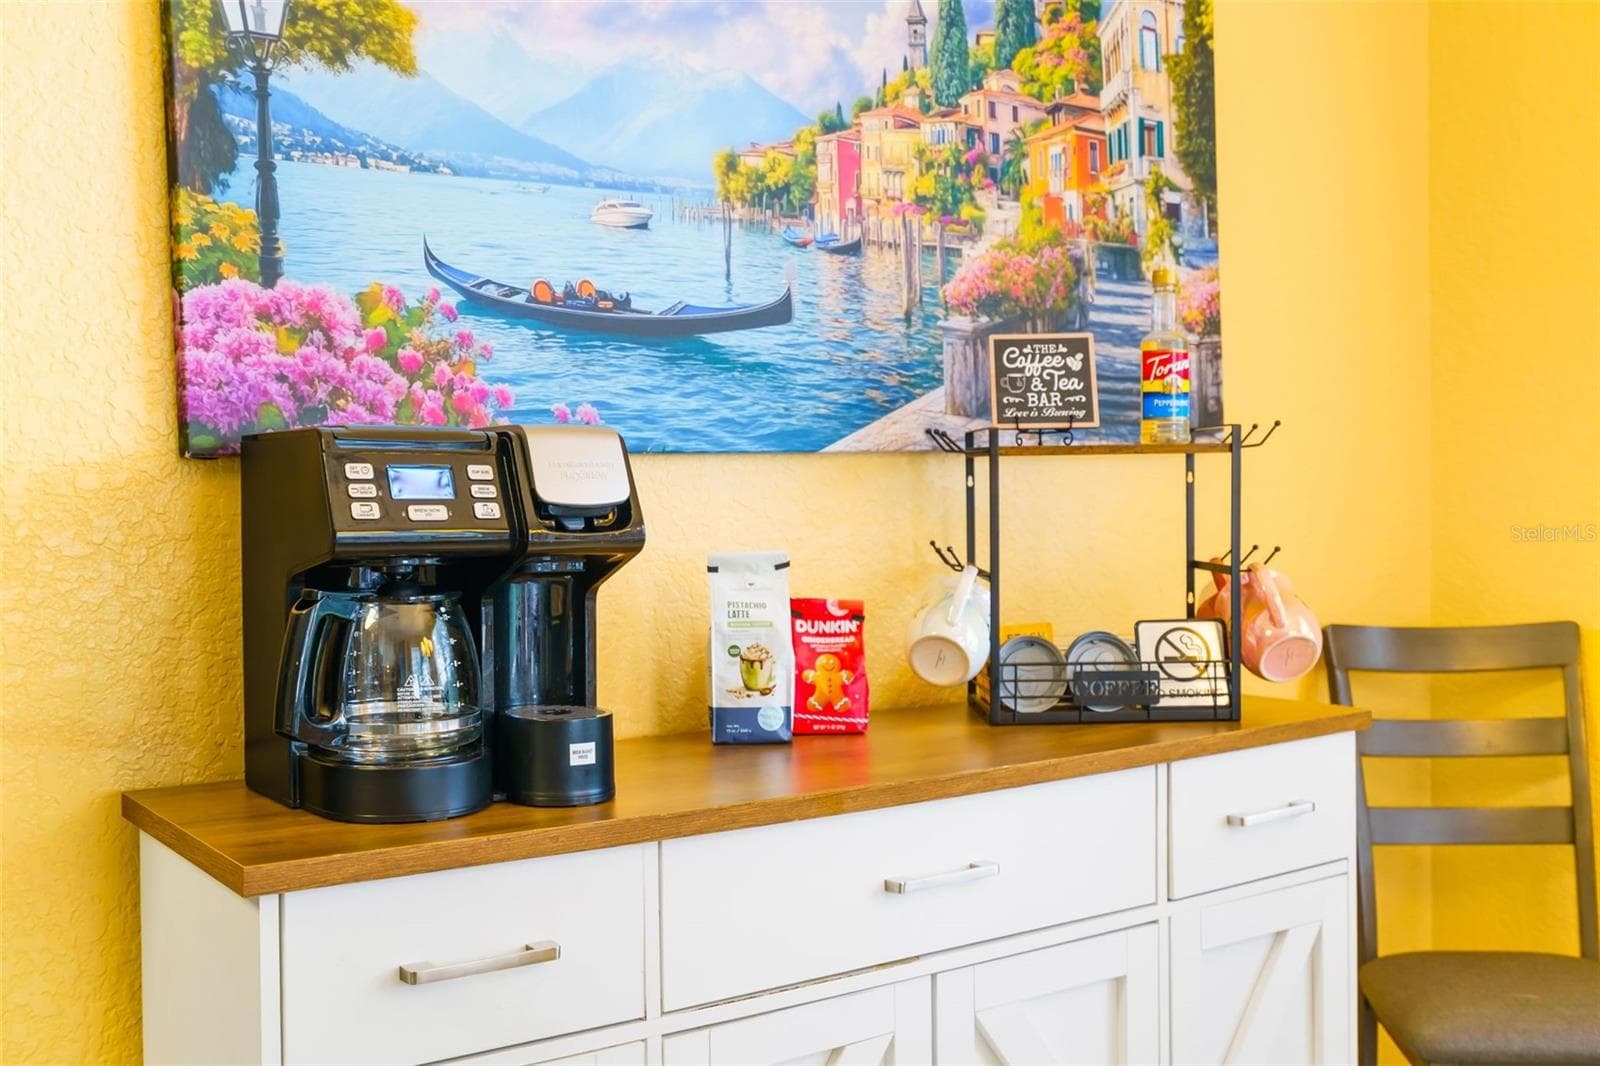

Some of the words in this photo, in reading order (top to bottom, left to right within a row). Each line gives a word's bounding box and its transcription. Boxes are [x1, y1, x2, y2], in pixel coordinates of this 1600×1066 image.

[1033, 344, 1057, 354] THE
[1003, 347, 1065, 376] Coffee
[1146, 353, 1189, 384] Toran
[1031, 377, 1047, 392] &
[1042, 369, 1084, 391] Tea
[1027, 392, 1063, 407] BAR
[1003, 407, 1029, 418] Love
[1030, 407, 1039, 417] is
[1041, 407, 1086, 419] Brewing
[727, 601, 767, 610] PISTACHIO
[727, 610, 750, 619] LATTE
[1075, 680, 1159, 696] COFFEE
[1168, 688, 1223, 698] SMOKIG
